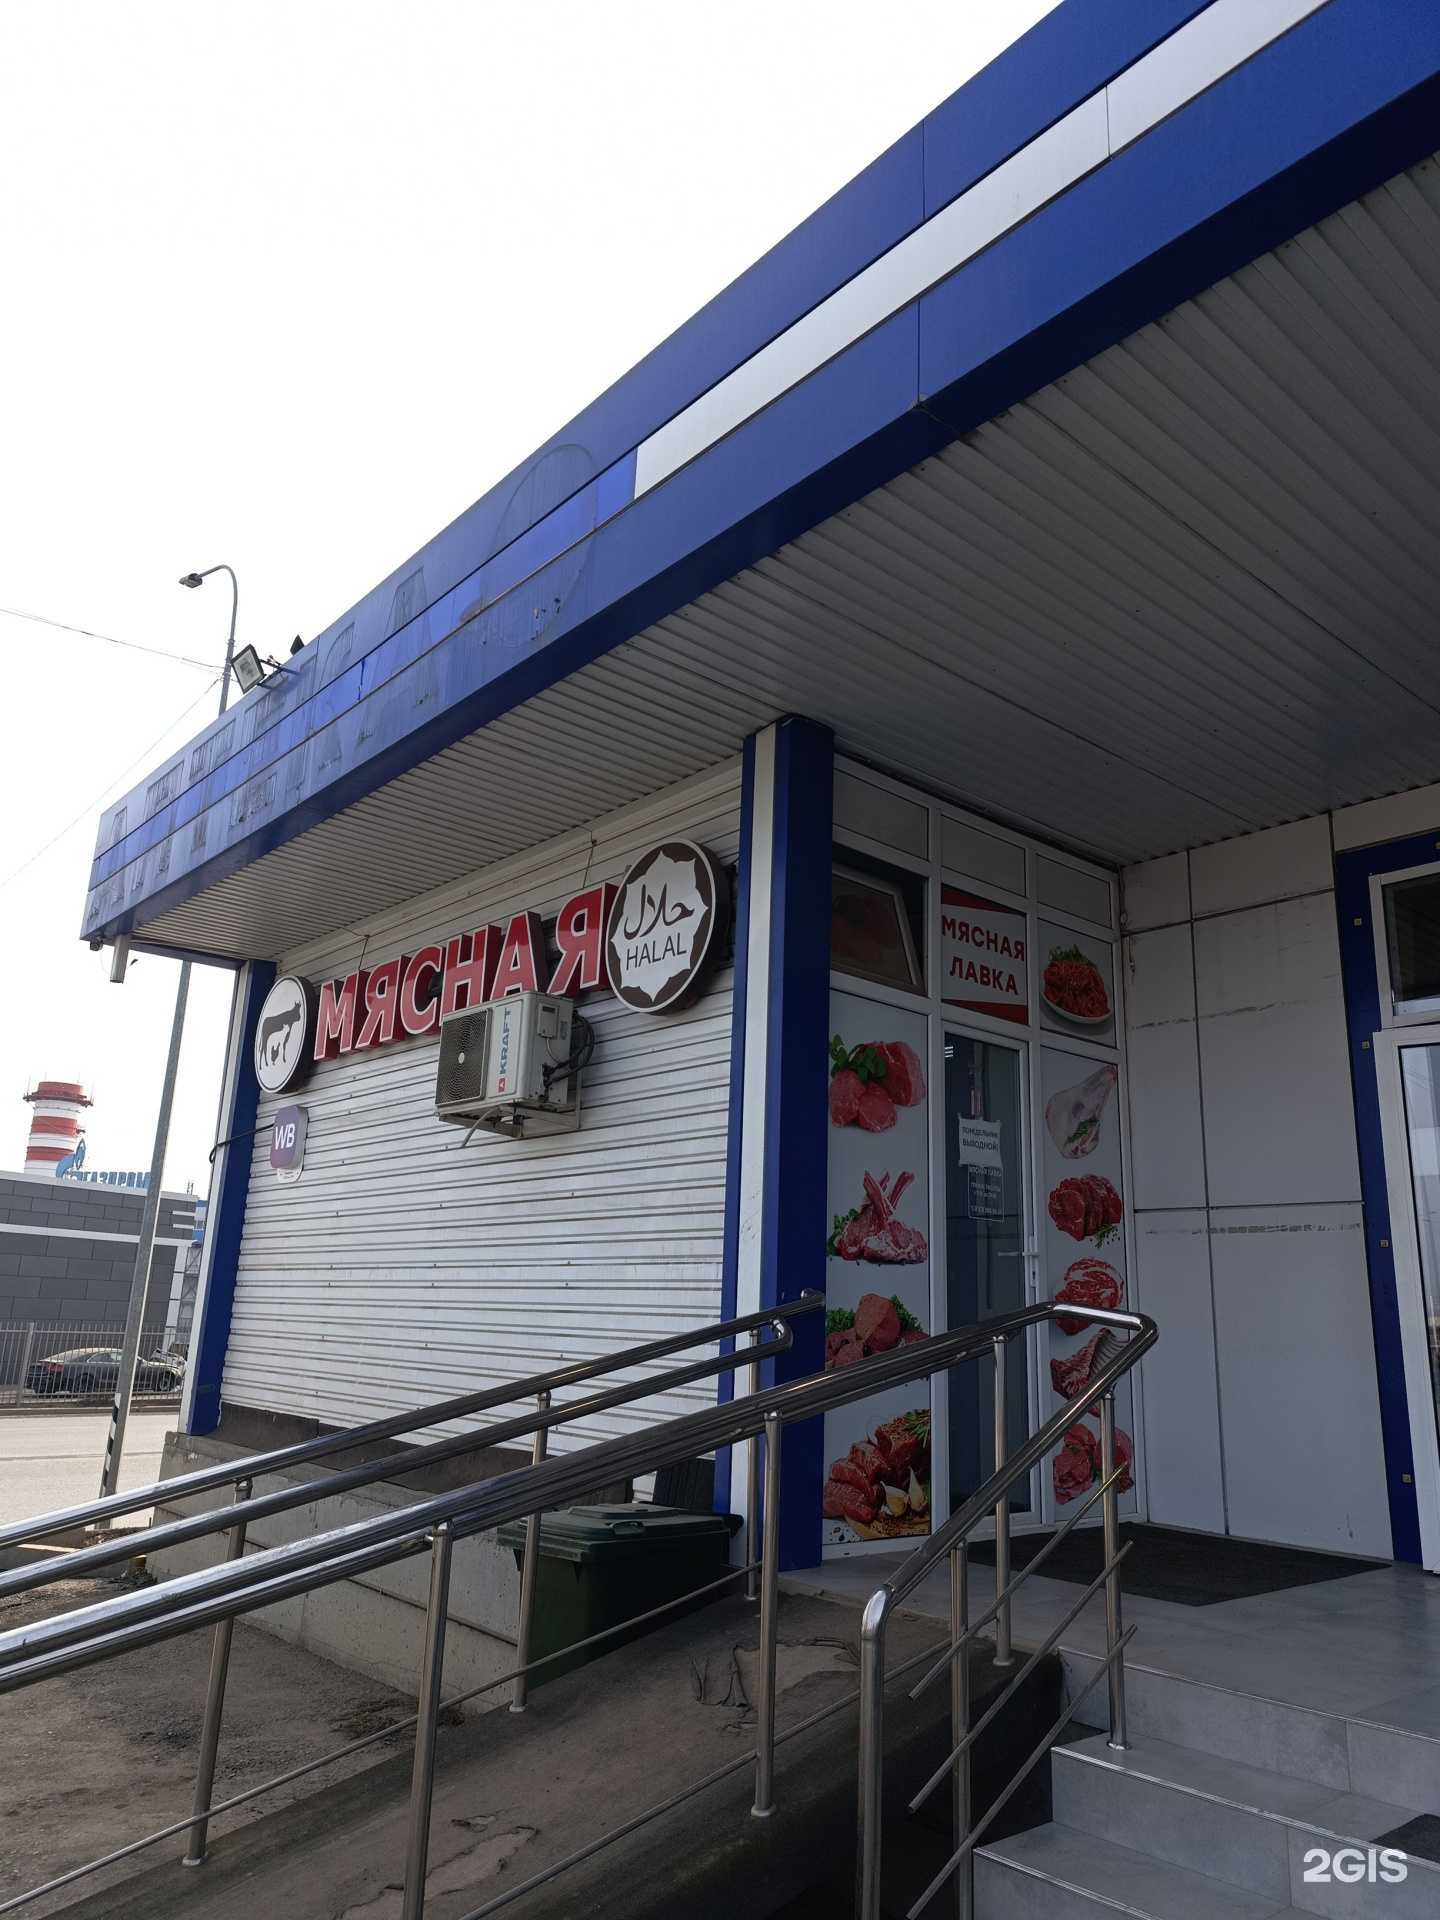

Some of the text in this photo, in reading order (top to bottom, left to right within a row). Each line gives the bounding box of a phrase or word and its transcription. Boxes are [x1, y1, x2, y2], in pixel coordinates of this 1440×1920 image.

[624, 884, 695, 940] حلال
[625, 932, 687, 971] HALAL
[941, 914, 1025, 962] МЯСНАЯ
[314, 886, 608, 1061] МЯСНАЯ
[949, 956, 1018, 996] ЛАВКА
[498, 1007, 512, 1076] KRAFT
[274, 1123, 296, 1151] WB
[82, 1171, 151, 1189] ГАЗПРОМ
